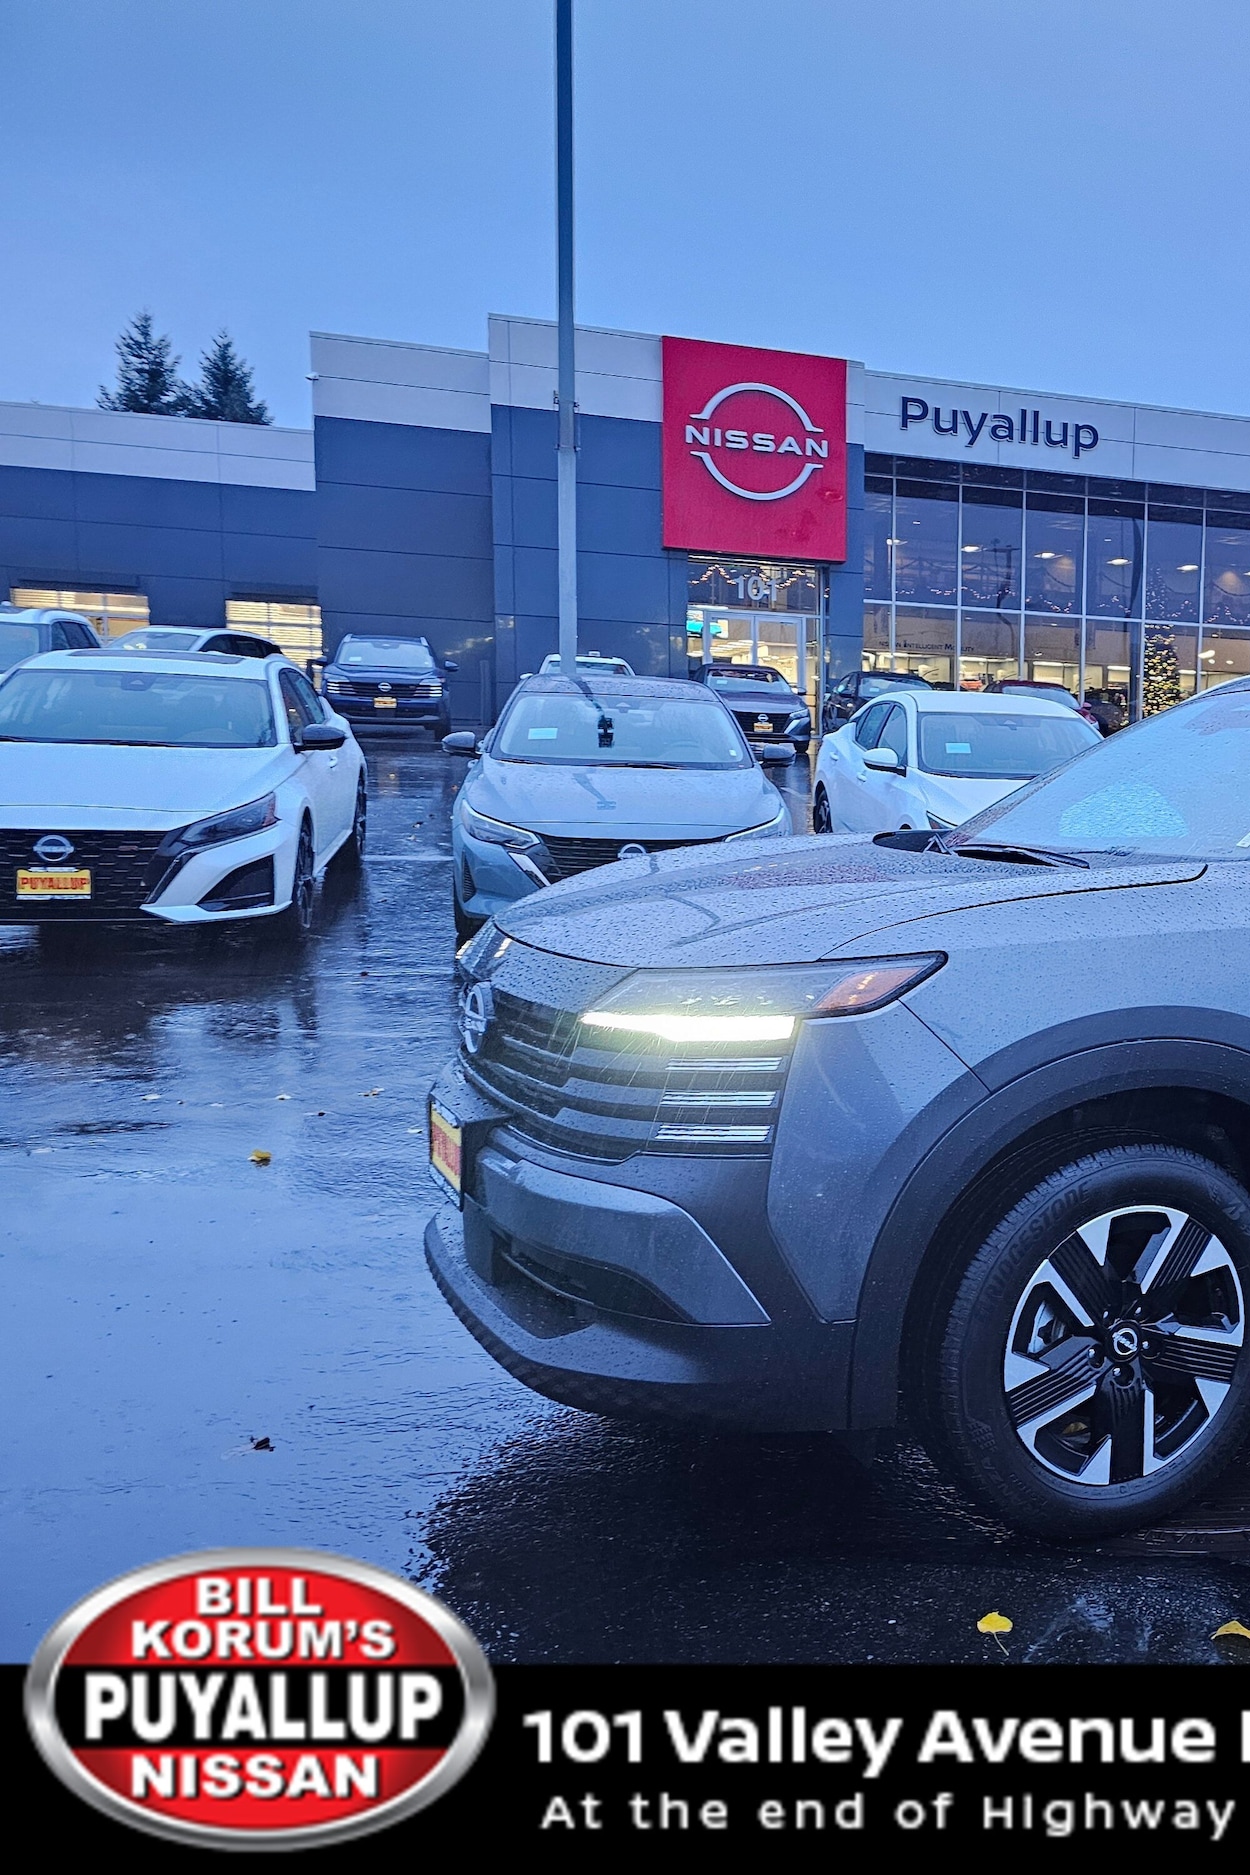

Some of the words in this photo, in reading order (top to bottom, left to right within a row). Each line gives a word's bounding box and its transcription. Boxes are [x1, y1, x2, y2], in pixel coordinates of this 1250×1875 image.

[685, 424, 829, 458] NISSAN
[900, 395, 1100, 459] Puyallup
[734, 575, 777, 602] 101
[18, 876, 90, 890] PUYALLUP
